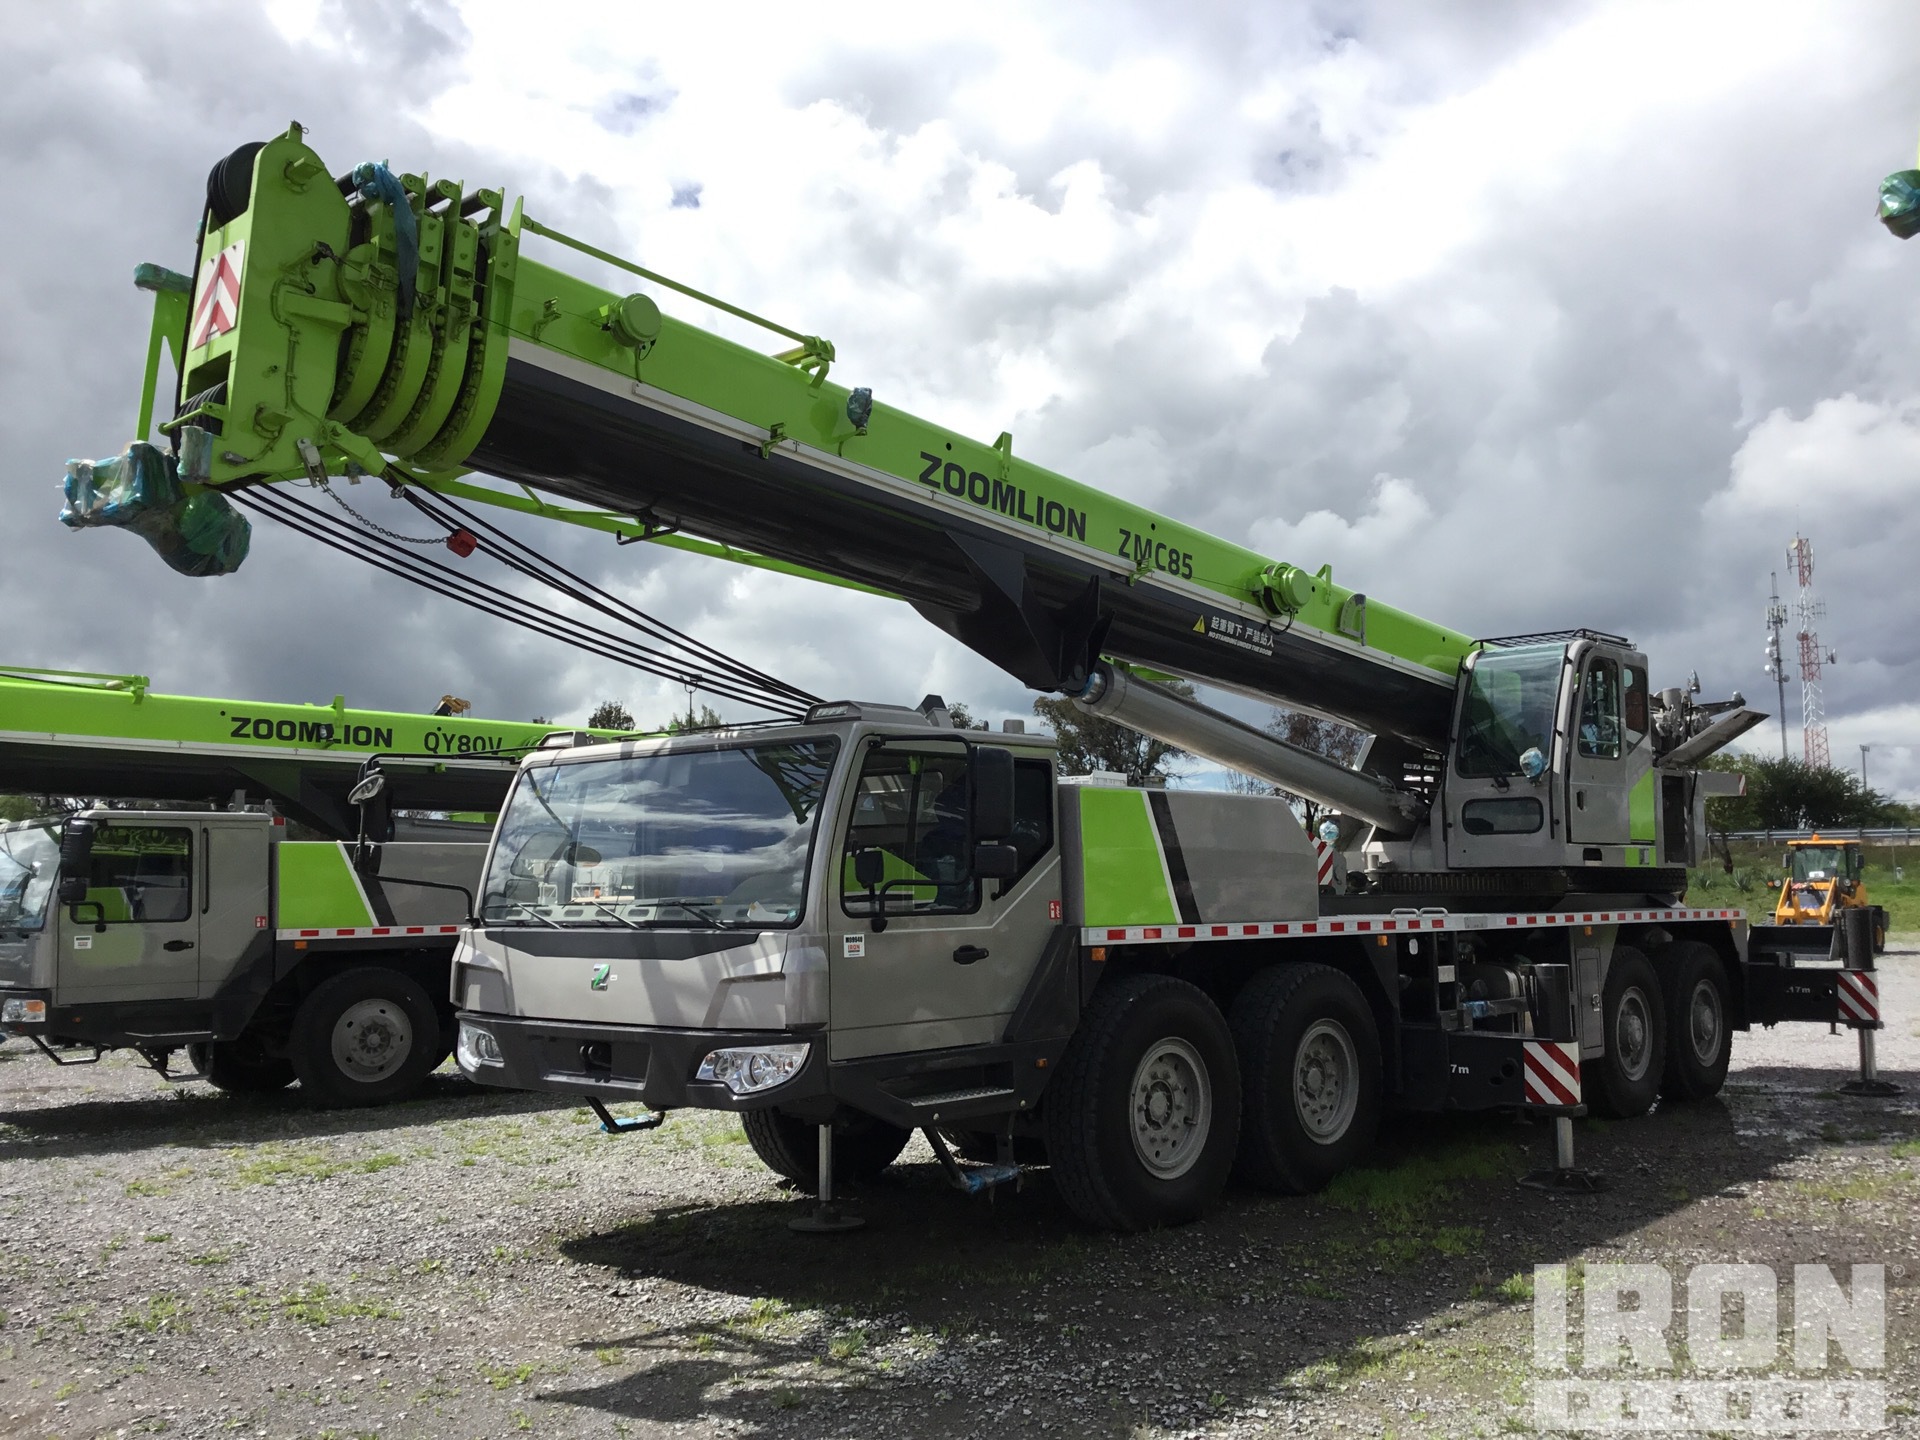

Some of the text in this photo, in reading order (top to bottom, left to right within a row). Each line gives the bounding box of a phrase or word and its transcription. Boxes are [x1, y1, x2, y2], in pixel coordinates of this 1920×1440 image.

[918, 451, 1193, 580] ZOOMLION ZMC85
[424, 731, 503, 755] QY80V
